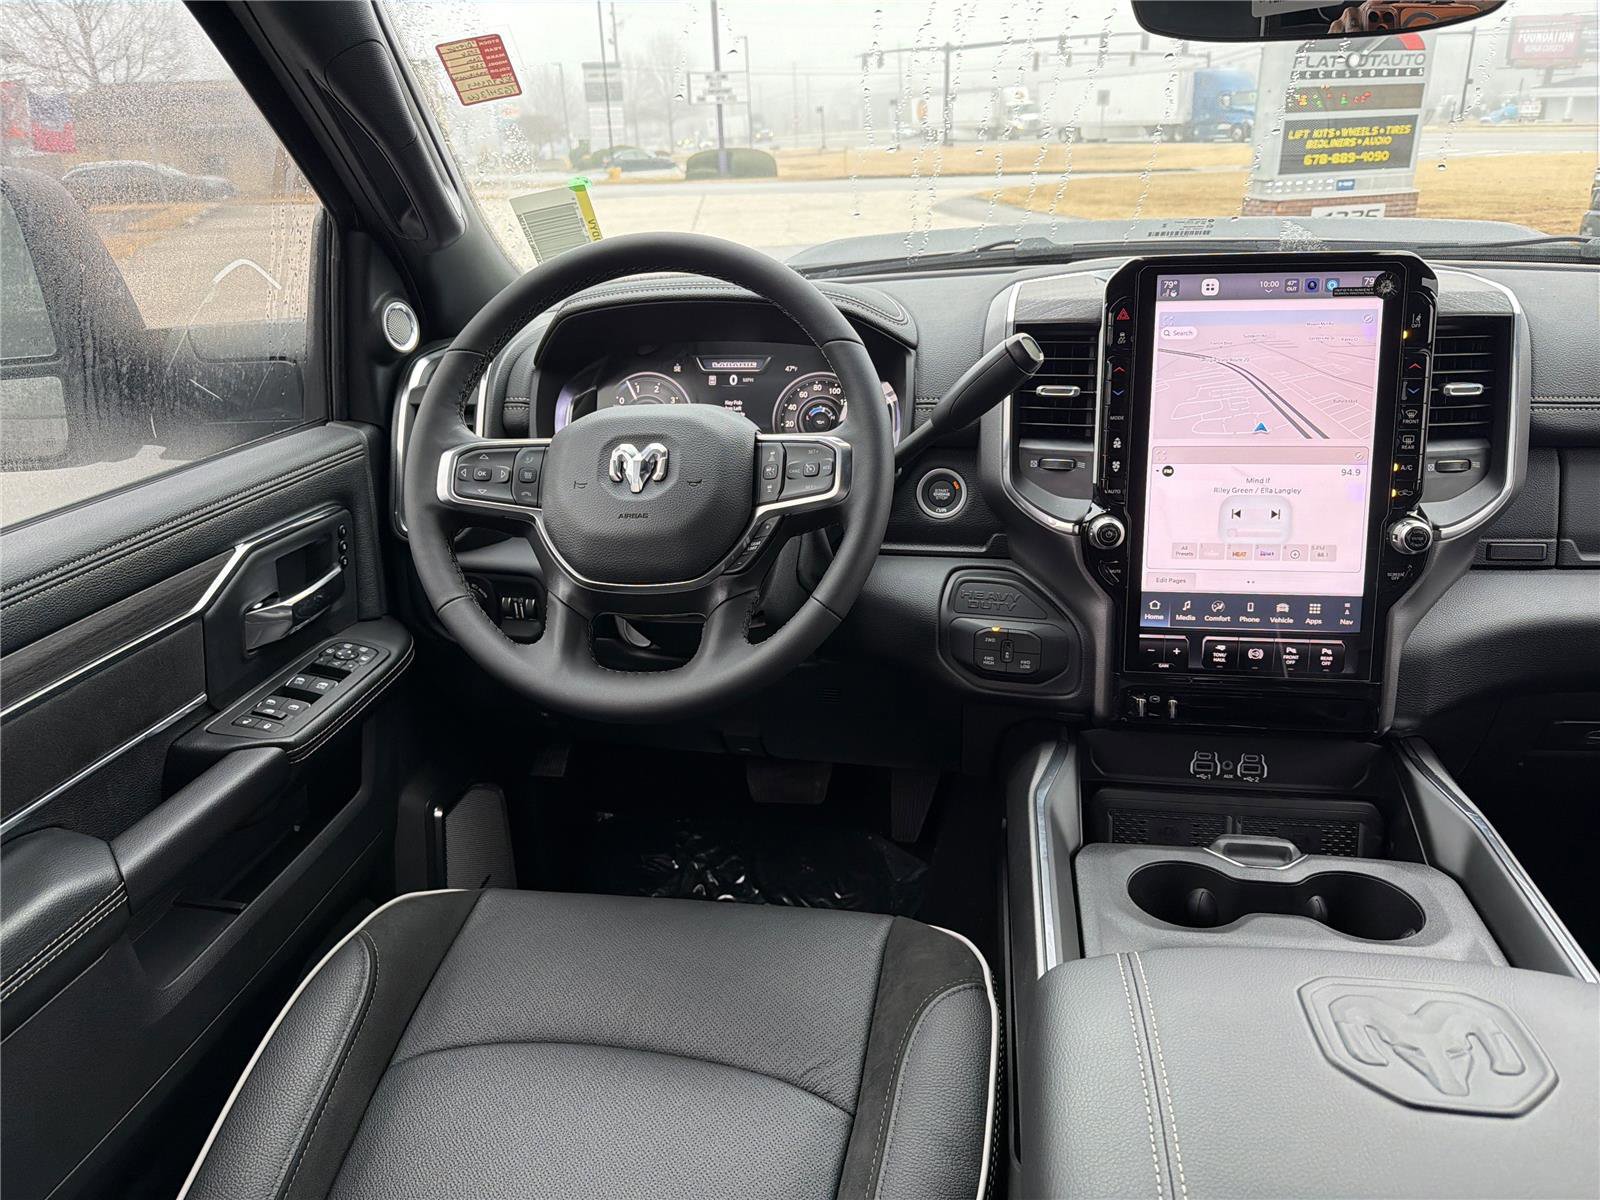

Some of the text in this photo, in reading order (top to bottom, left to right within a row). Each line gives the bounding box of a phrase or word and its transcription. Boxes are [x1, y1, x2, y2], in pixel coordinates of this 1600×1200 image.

[1518, 29, 1576, 43] FOUNDATION
[1288, 129, 1311, 140] LIFT
[1260, 280, 1280, 288] 10:00
[1173, 329, 1193, 337] Search
[729, 374, 738, 386] 0
[654, 385, 660, 393] 2
[829, 387, 841, 395] 100
[619, 397, 625, 405] 0
[670, 396, 676, 404] 3
[785, 420, 795, 428] 20
[1341, 468, 1361, 476] 94.9
[1214, 487, 1230, 495] Riley
[1275, 487, 1302, 496] Langley
[1168, 577, 1186, 585] Pages
[961, 590, 1021, 603] HEAVY
[968, 600, 1016, 612] DUTY
[1239, 615, 1260, 623] Phone
[1269, 616, 1294, 624] Vehicle
[1305, 617, 1322, 625] Apps
